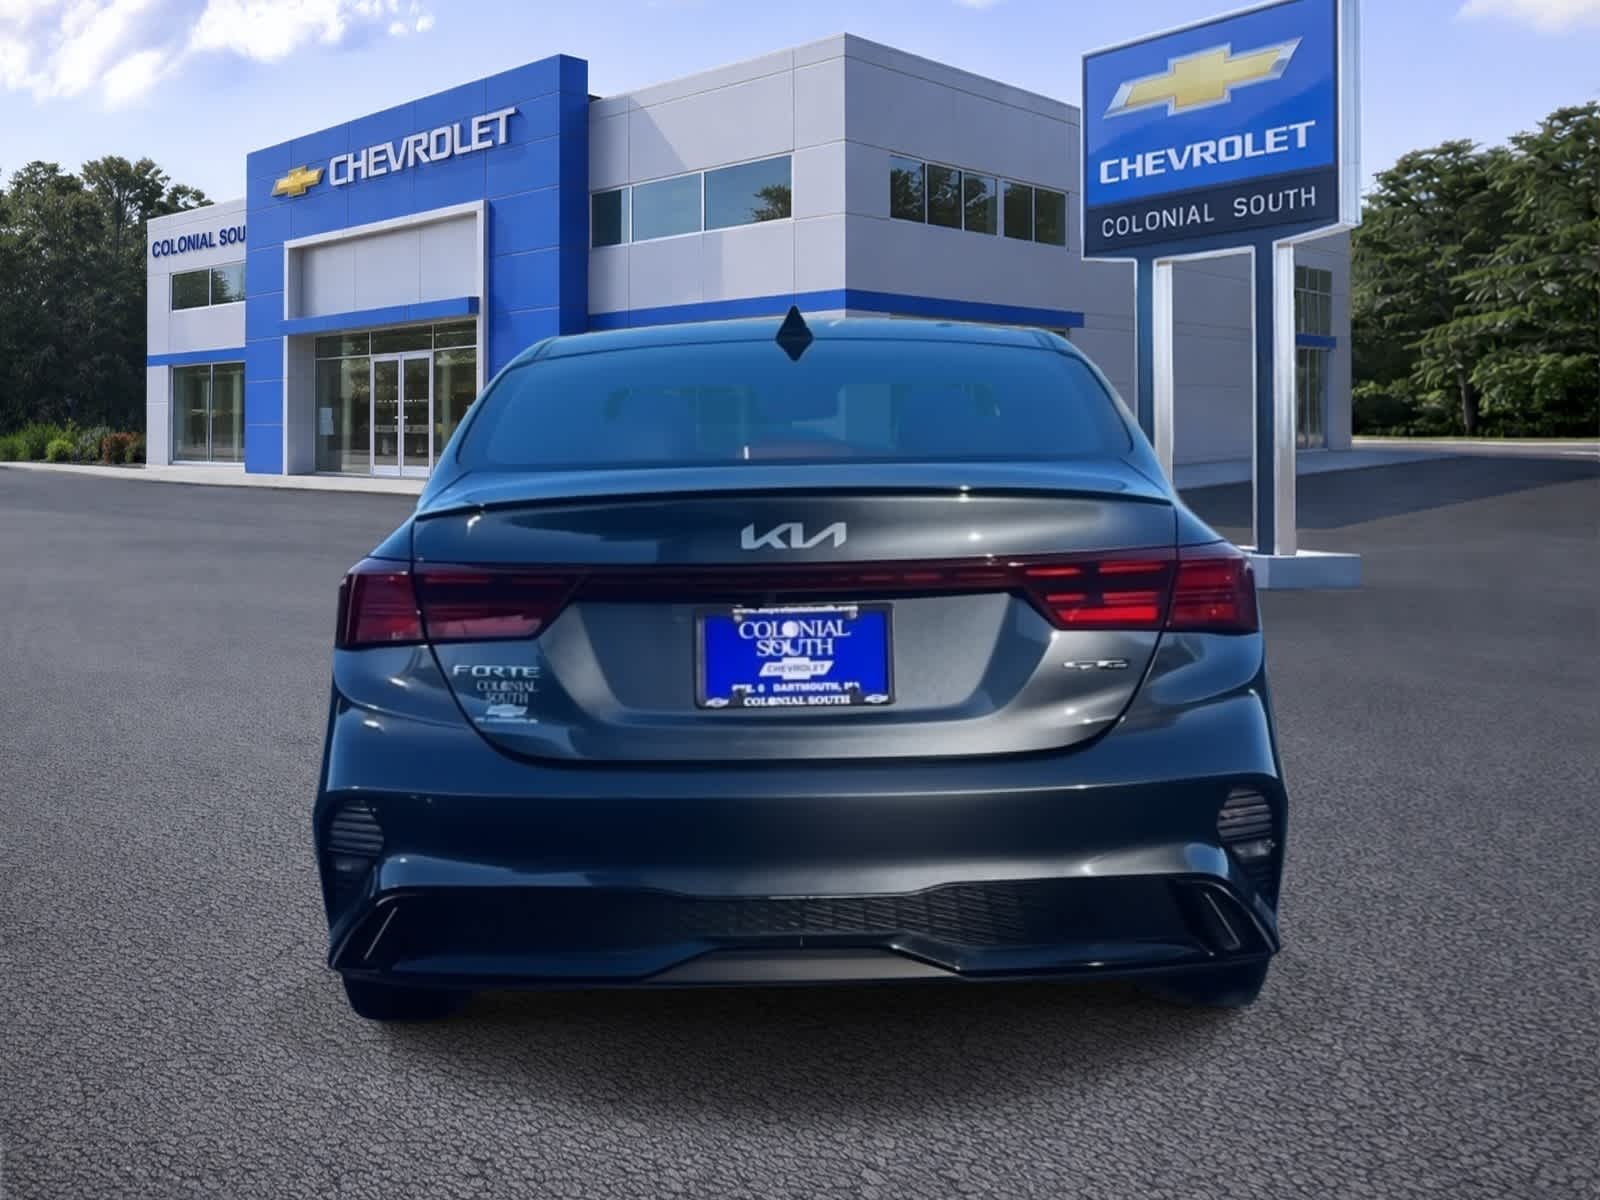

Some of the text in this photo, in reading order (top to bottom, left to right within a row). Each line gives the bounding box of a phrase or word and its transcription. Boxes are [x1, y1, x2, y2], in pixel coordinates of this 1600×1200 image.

[329, 106, 517, 186] CHEVROLET
[1100, 120, 1316, 184] CHEVROLET
[1102, 186, 1316, 237] COLONIAL SOUTH
[152, 225, 246, 258] COLONIAL SOU
[741, 522, 847, 549] KIA
[739, 619, 851, 639] COLONIAL
[757, 638, 834, 657] SOUTH
[453, 665, 540, 678] FORTE
[744, 694, 850, 706] COLONIAL SOUTH
